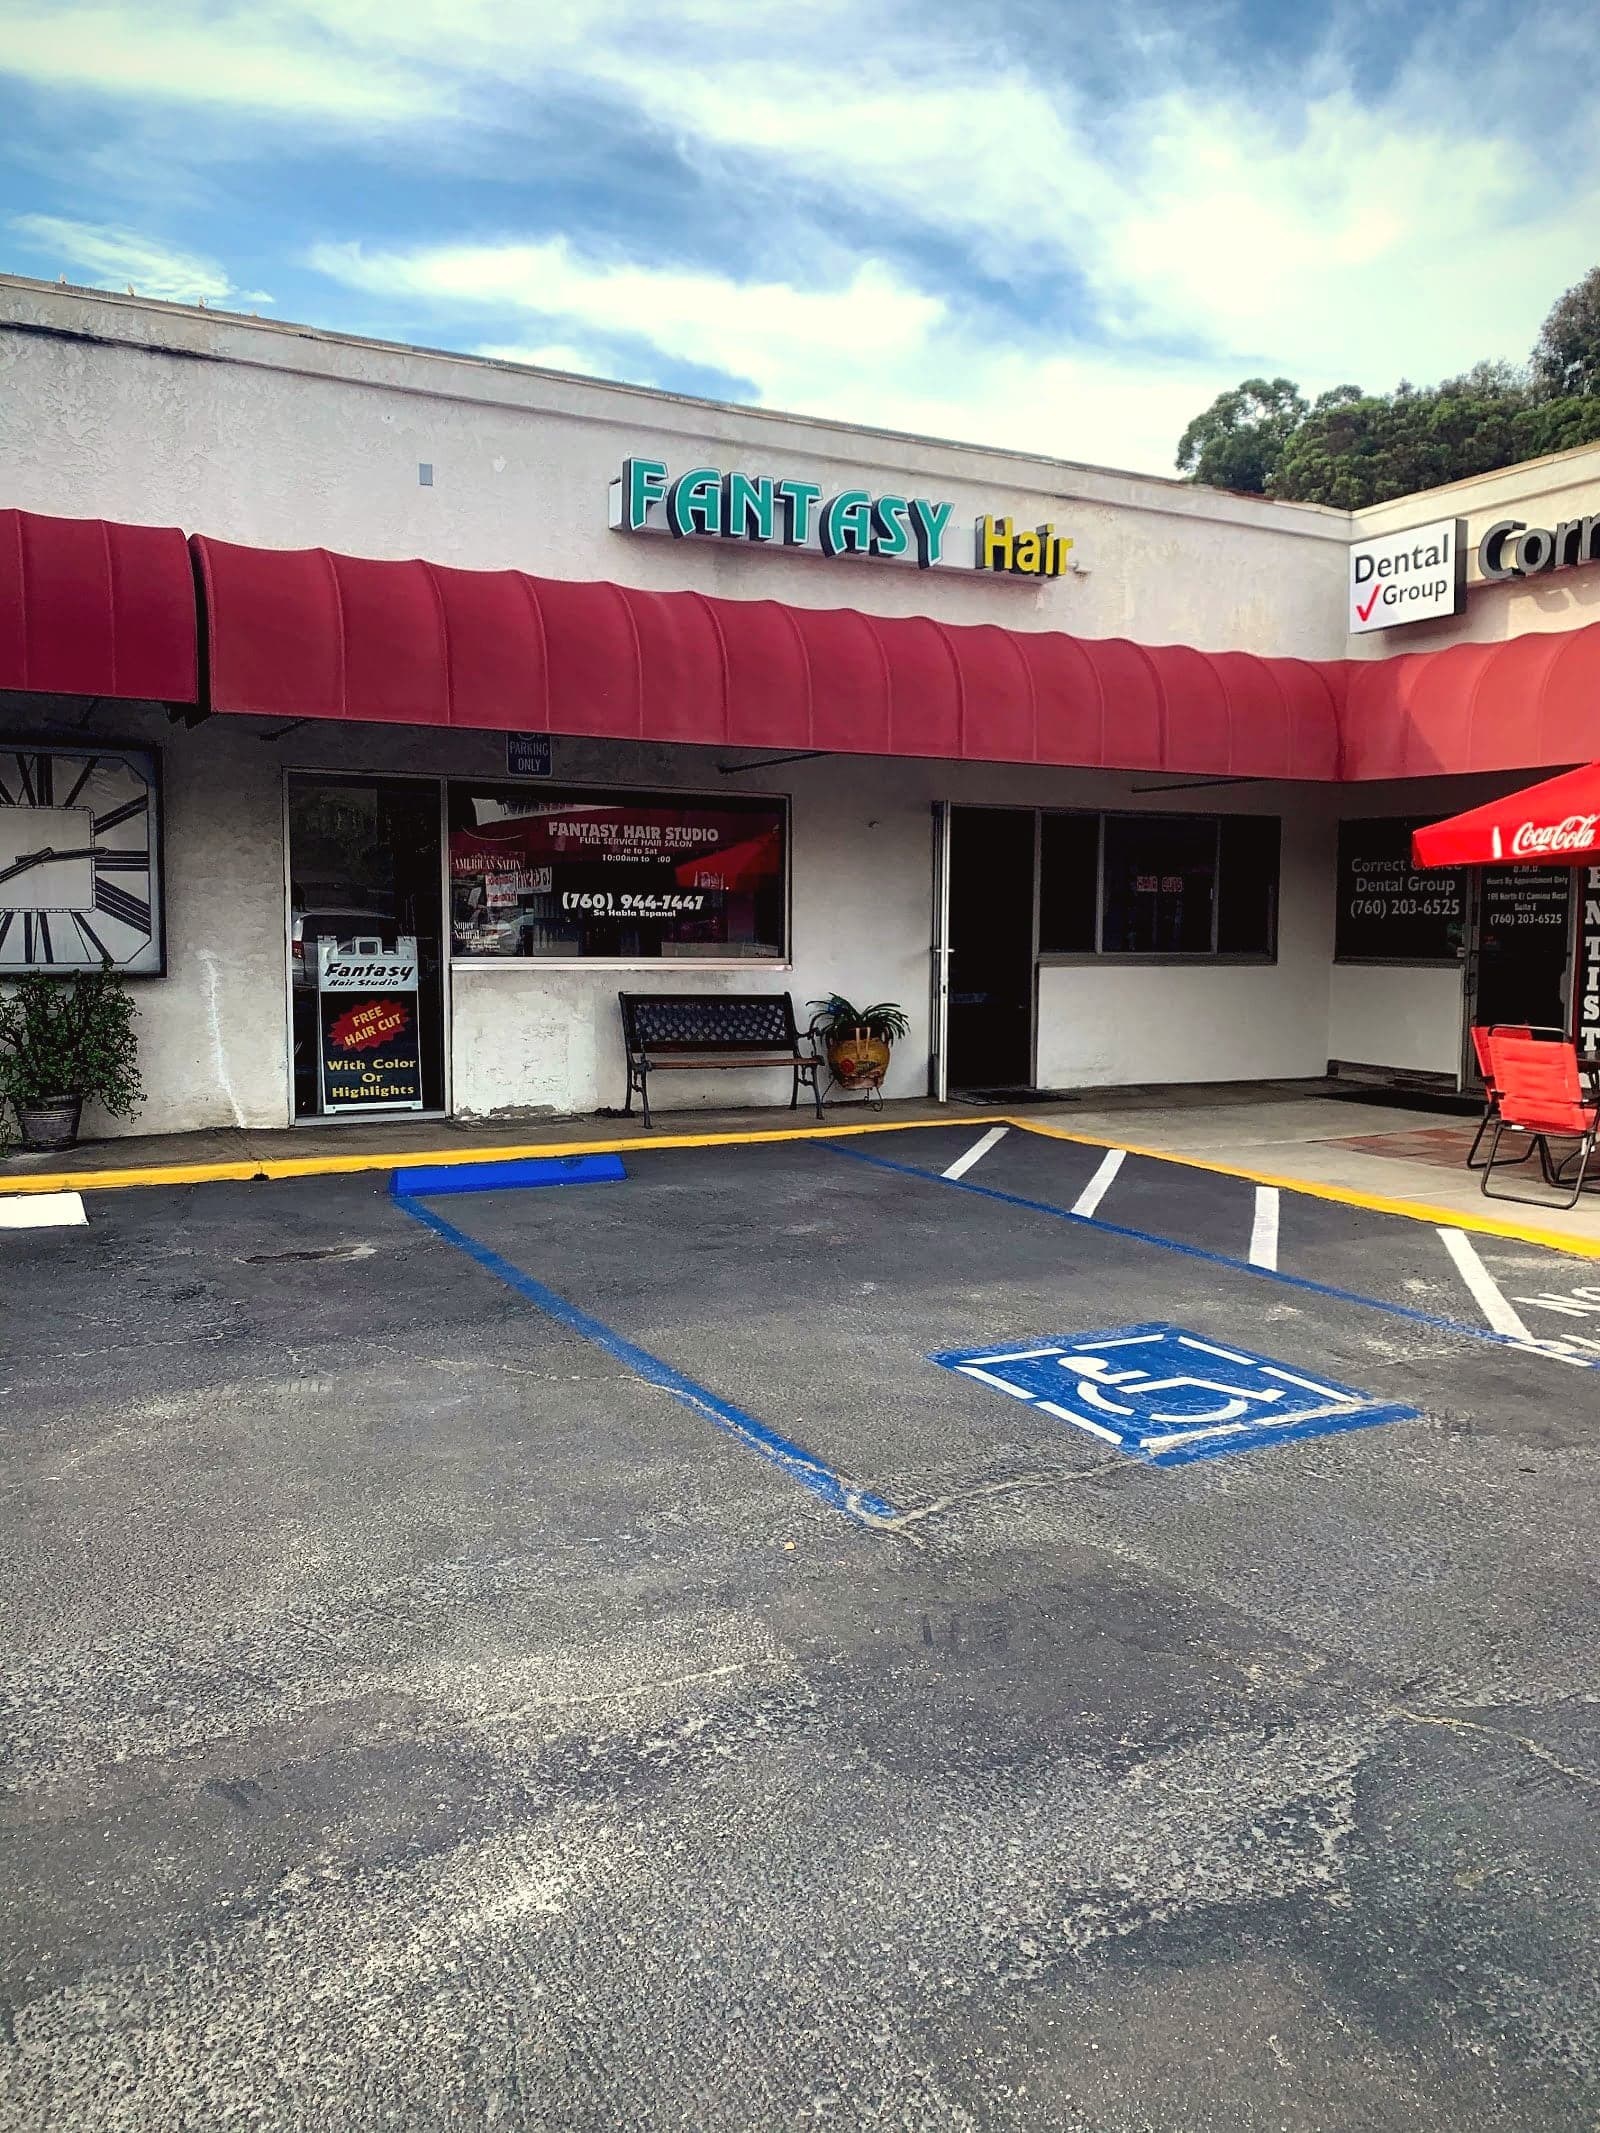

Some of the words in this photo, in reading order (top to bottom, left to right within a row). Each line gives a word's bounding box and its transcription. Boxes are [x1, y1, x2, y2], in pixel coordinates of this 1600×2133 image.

[623, 457, 955, 569] FANTASY
[979, 514, 1074, 577] Hair
[1355, 533, 1449, 584] Dental
[1382, 577, 1448, 607] Group
[510, 741, 549, 757] PARKING
[518, 757, 541, 772] ONLY
[549, 821, 619, 839] FANTASY
[624, 824, 661, 840] HAIR
[665, 826, 719, 842] STUDIO
[579, 836, 602, 845] FULL
[603, 837, 639, 847] SERVICE
[664, 839, 693, 848] SALON
[644, 847, 658, 855] Sat
[1351, 857, 1407, 873] Correct
[1356, 876, 1404, 893] Dental
[1407, 876, 1456, 896] Group
[562, 892, 614, 910] (760)
[621, 893, 704, 910] 944-7447
[1350, 898, 1387, 920] (760)
[1391, 898, 1461, 915] 203-6525
[593, 909, 606, 917] Se
[607, 909, 637, 918] Habla
[639, 909, 677, 919] Espanol
[1490, 913, 1515, 926] (760)
[1517, 913, 1562, 924] 203-6525
[453, 920, 475, 931] Super
[324, 962, 415, 982] Fantasy
[328, 979, 355, 987] Hair
[357, 978, 400, 987] Studio
[352, 1006, 384, 1027] FREE
[344, 1025, 377, 1046] HAIR
[378, 1013, 402, 1032] CUT
[327, 1059, 366, 1071] With
[372, 1058, 416, 1070] Color
[361, 1072, 384, 1083] Or
[331, 1084, 415, 1099] Highlights
